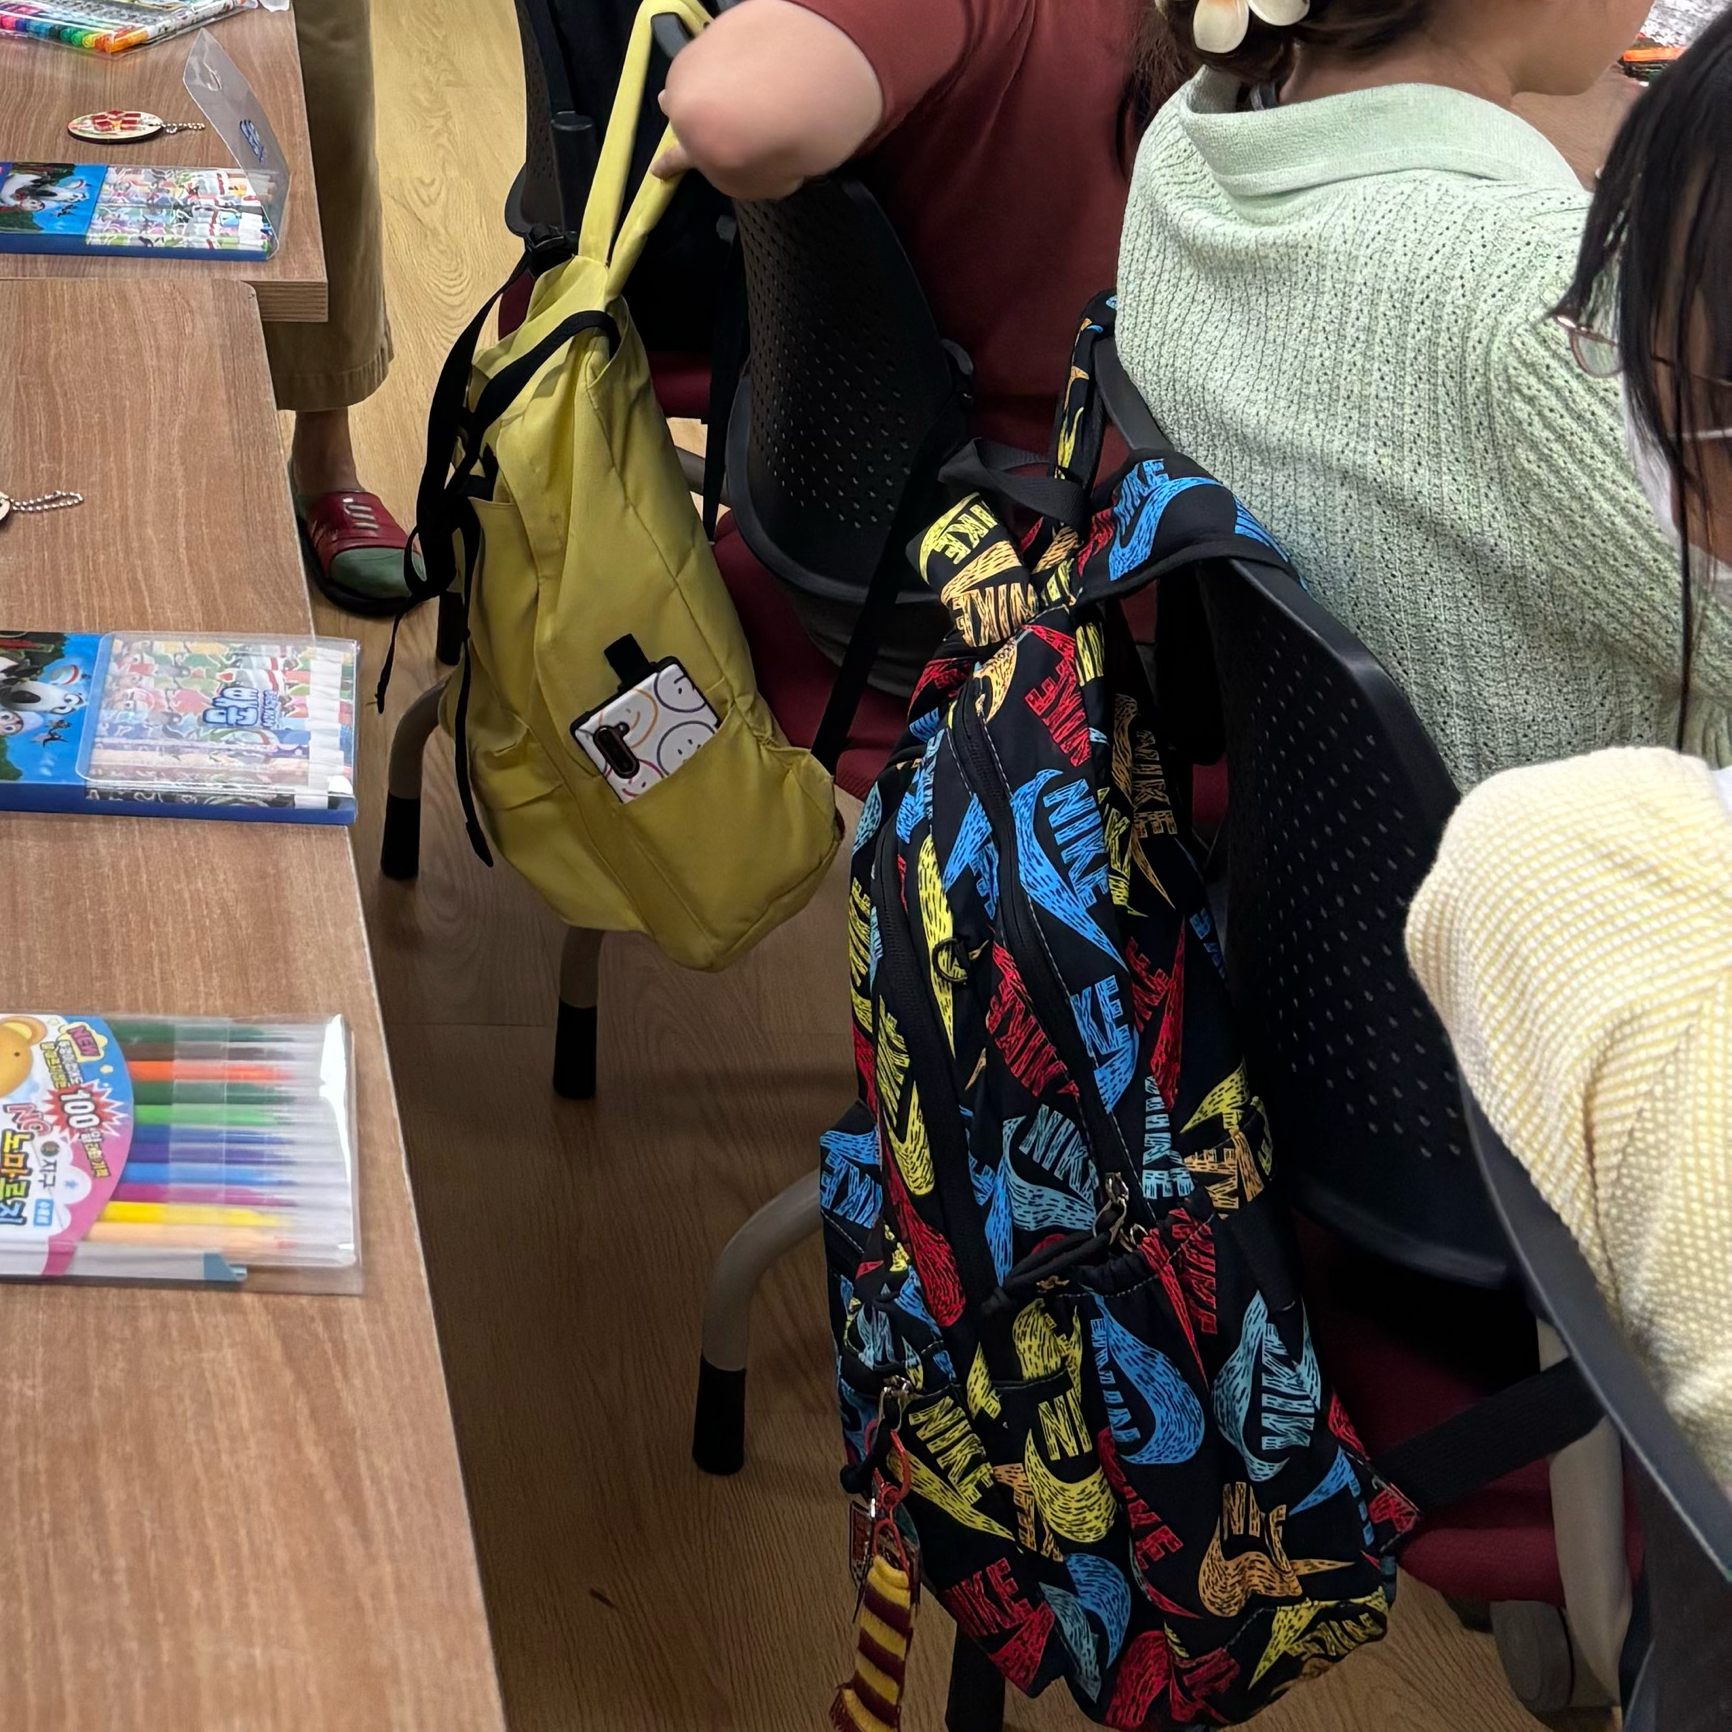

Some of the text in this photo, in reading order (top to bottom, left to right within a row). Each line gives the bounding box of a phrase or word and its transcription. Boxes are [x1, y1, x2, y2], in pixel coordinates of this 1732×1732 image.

[1043, 778, 1111, 908] NIKE
[68, 1024, 100, 1057] NEW
[59, 1088, 99, 1130] 100
[39, 1159, 57, 1189] 지구
[909, 1396, 995, 1505] NIKE
